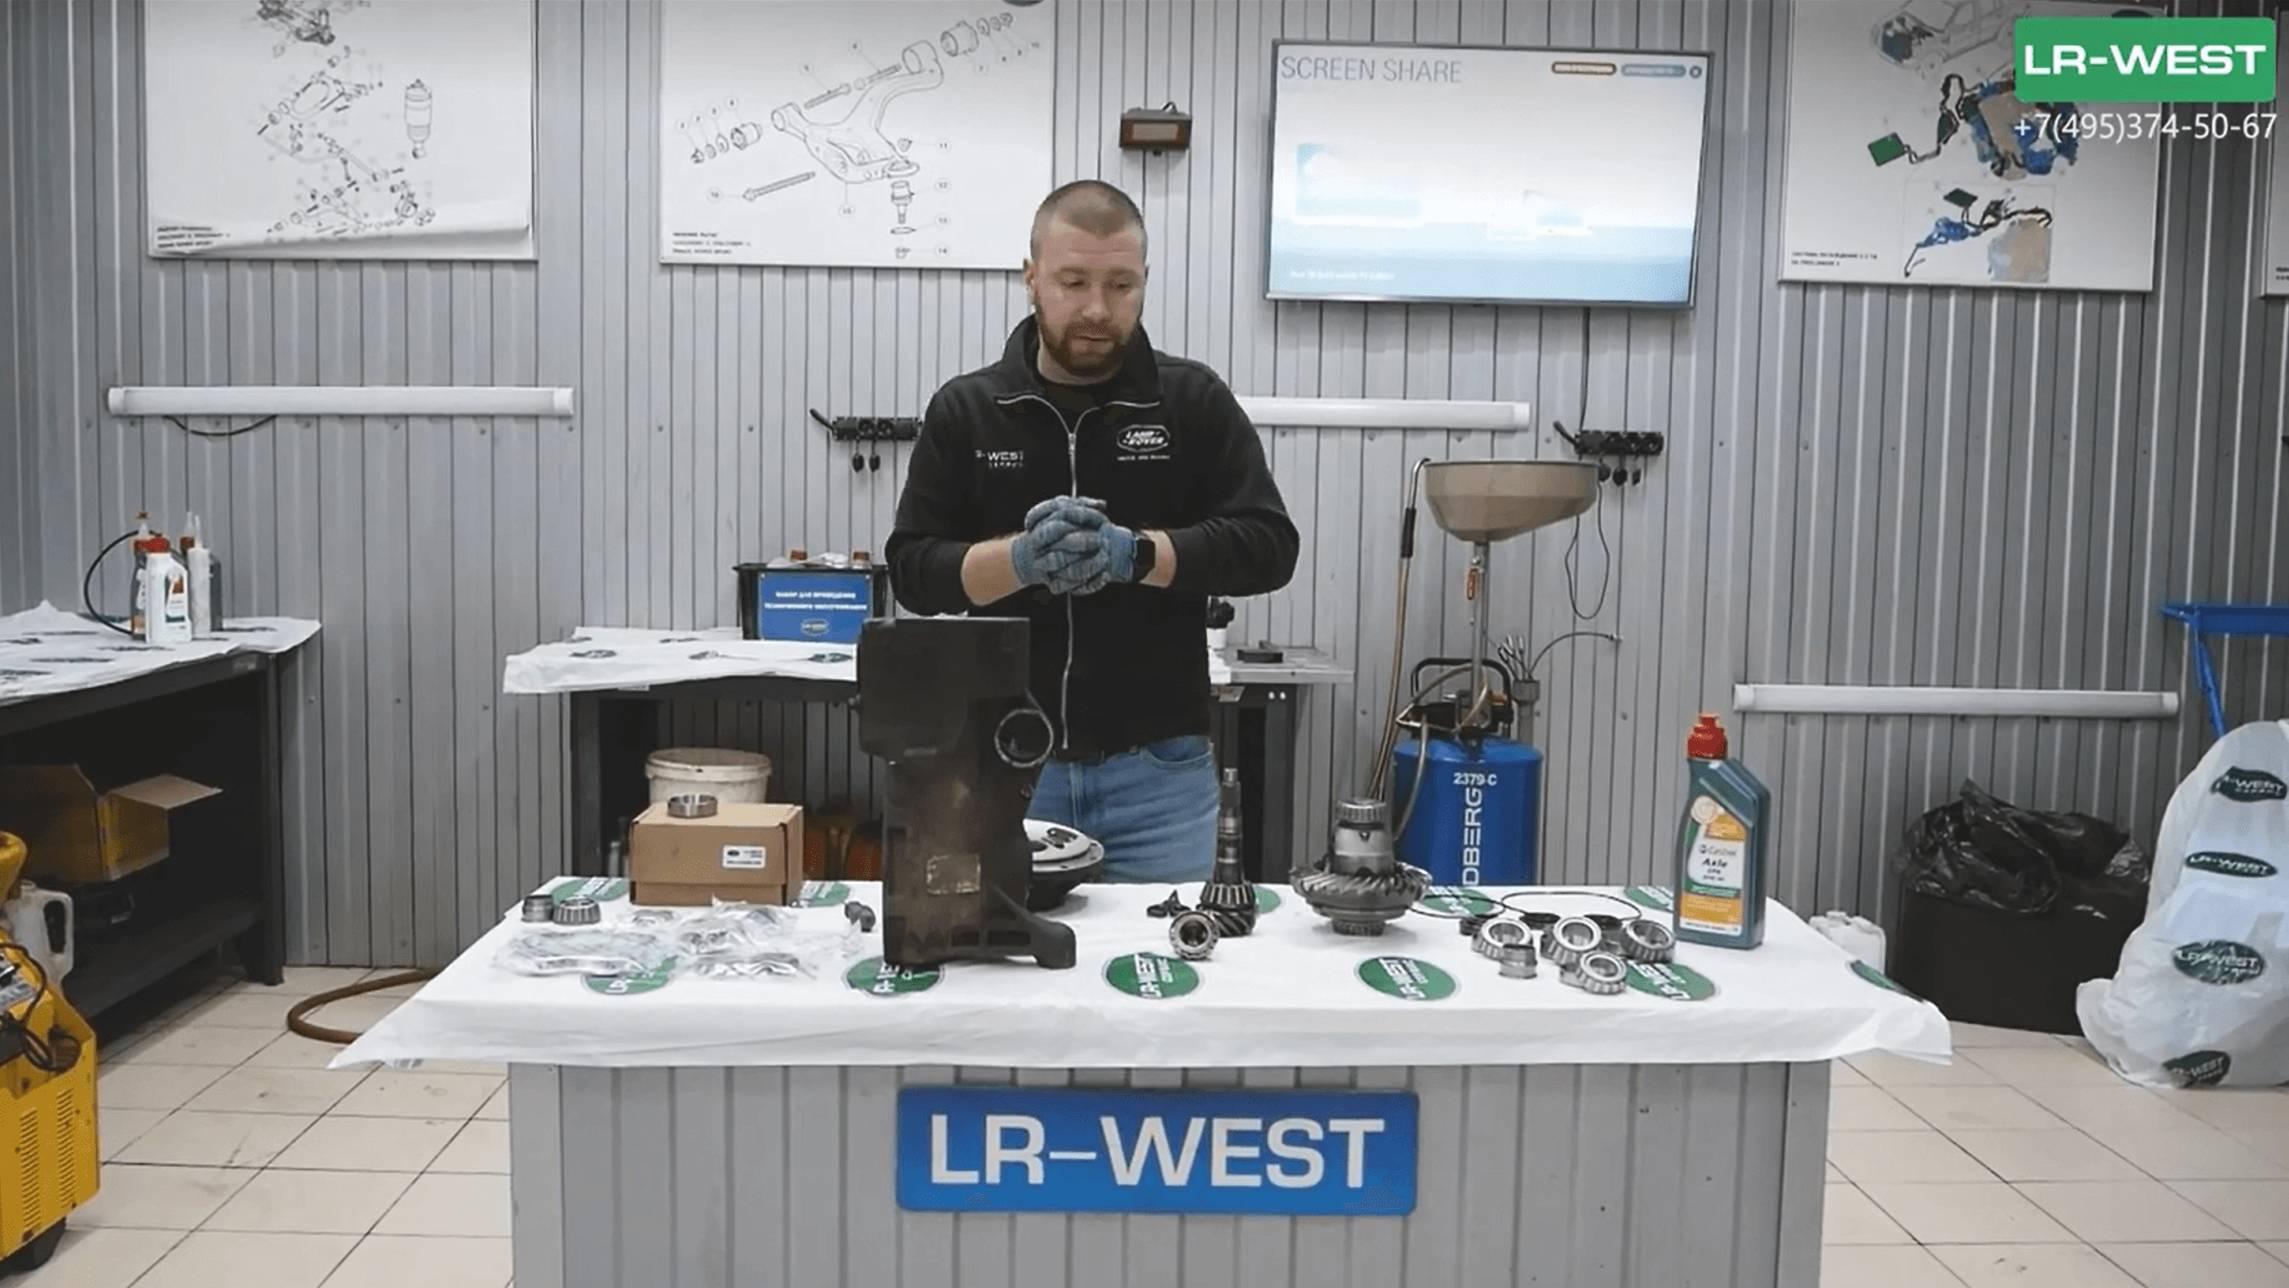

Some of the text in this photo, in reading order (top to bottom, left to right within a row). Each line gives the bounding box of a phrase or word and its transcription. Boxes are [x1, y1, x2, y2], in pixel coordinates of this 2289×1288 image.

[1281, 56, 1463, 84] SCREEN SHARE
[1125, 431, 1155, 439] LAND
[1128, 437, 1165, 446] ROVER
[931, 1113, 1385, 1189] LR-WEST
